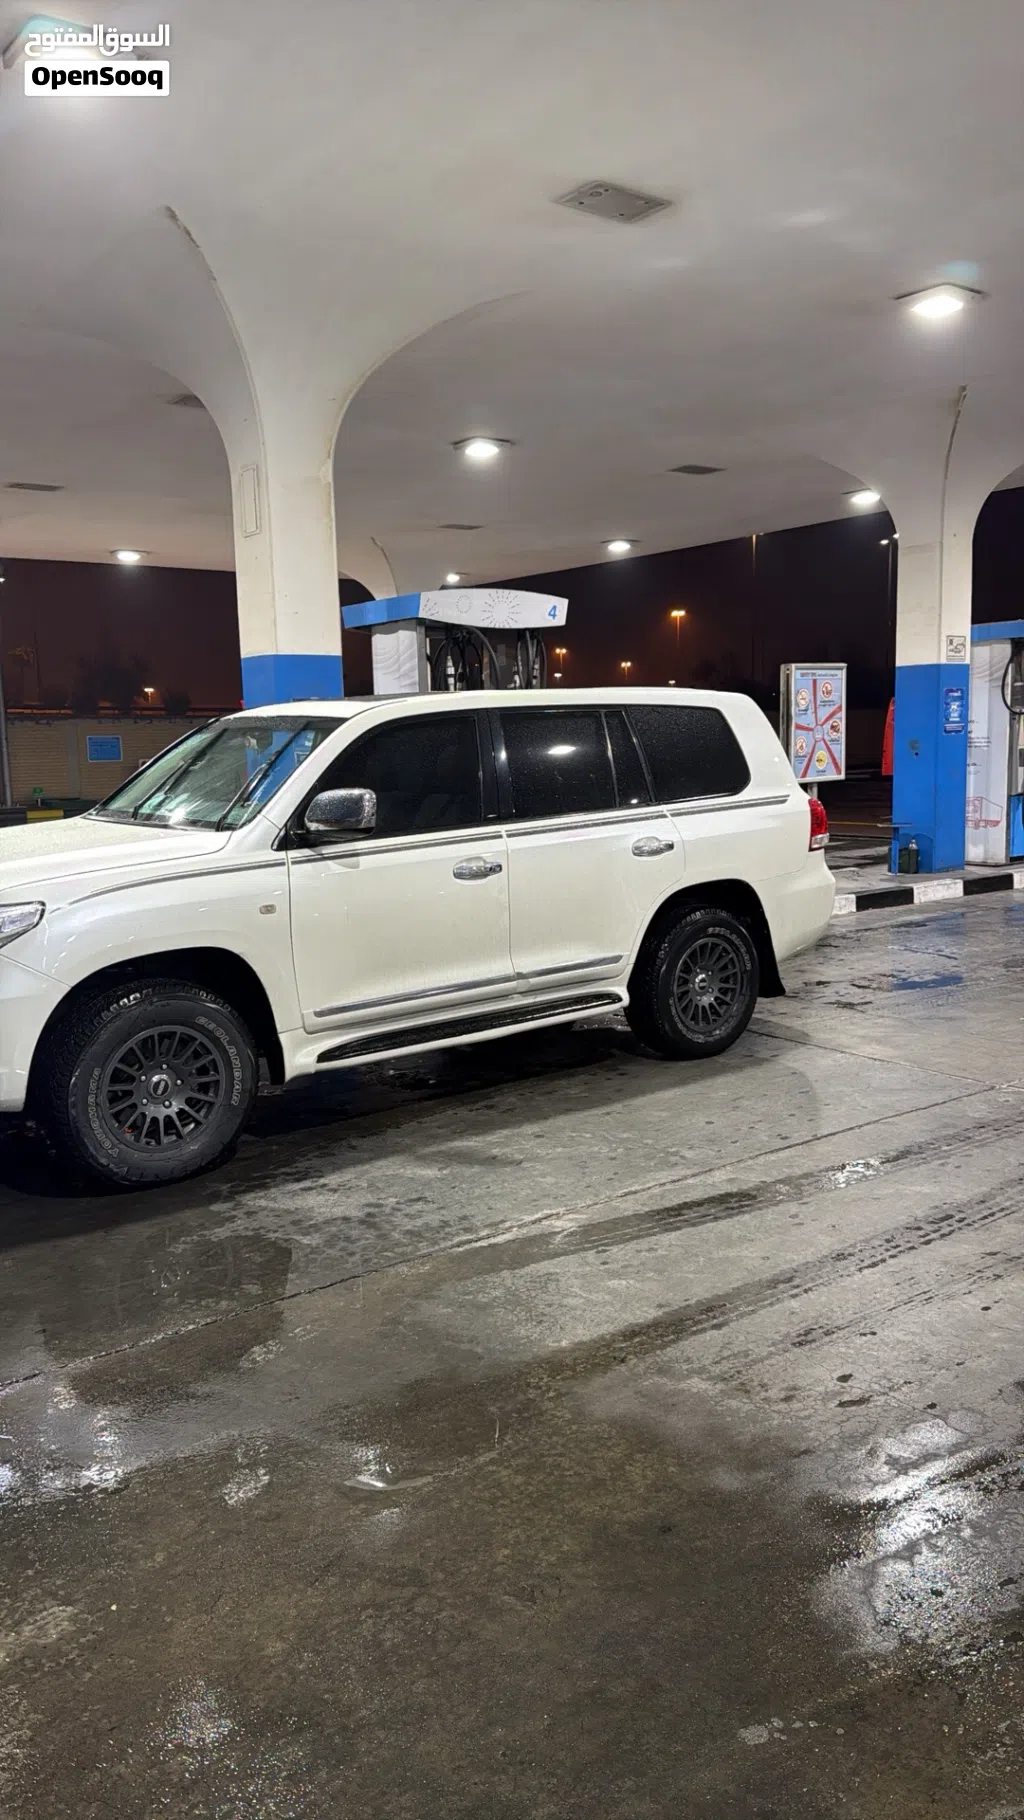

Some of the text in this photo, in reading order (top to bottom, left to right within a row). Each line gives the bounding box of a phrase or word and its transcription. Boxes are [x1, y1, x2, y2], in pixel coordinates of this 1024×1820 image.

[548, 605, 558, 620] 4
[195, 1016, 243, 1106] GEOLANDAR
[87, 1067, 119, 1158] YOKOHAMA
